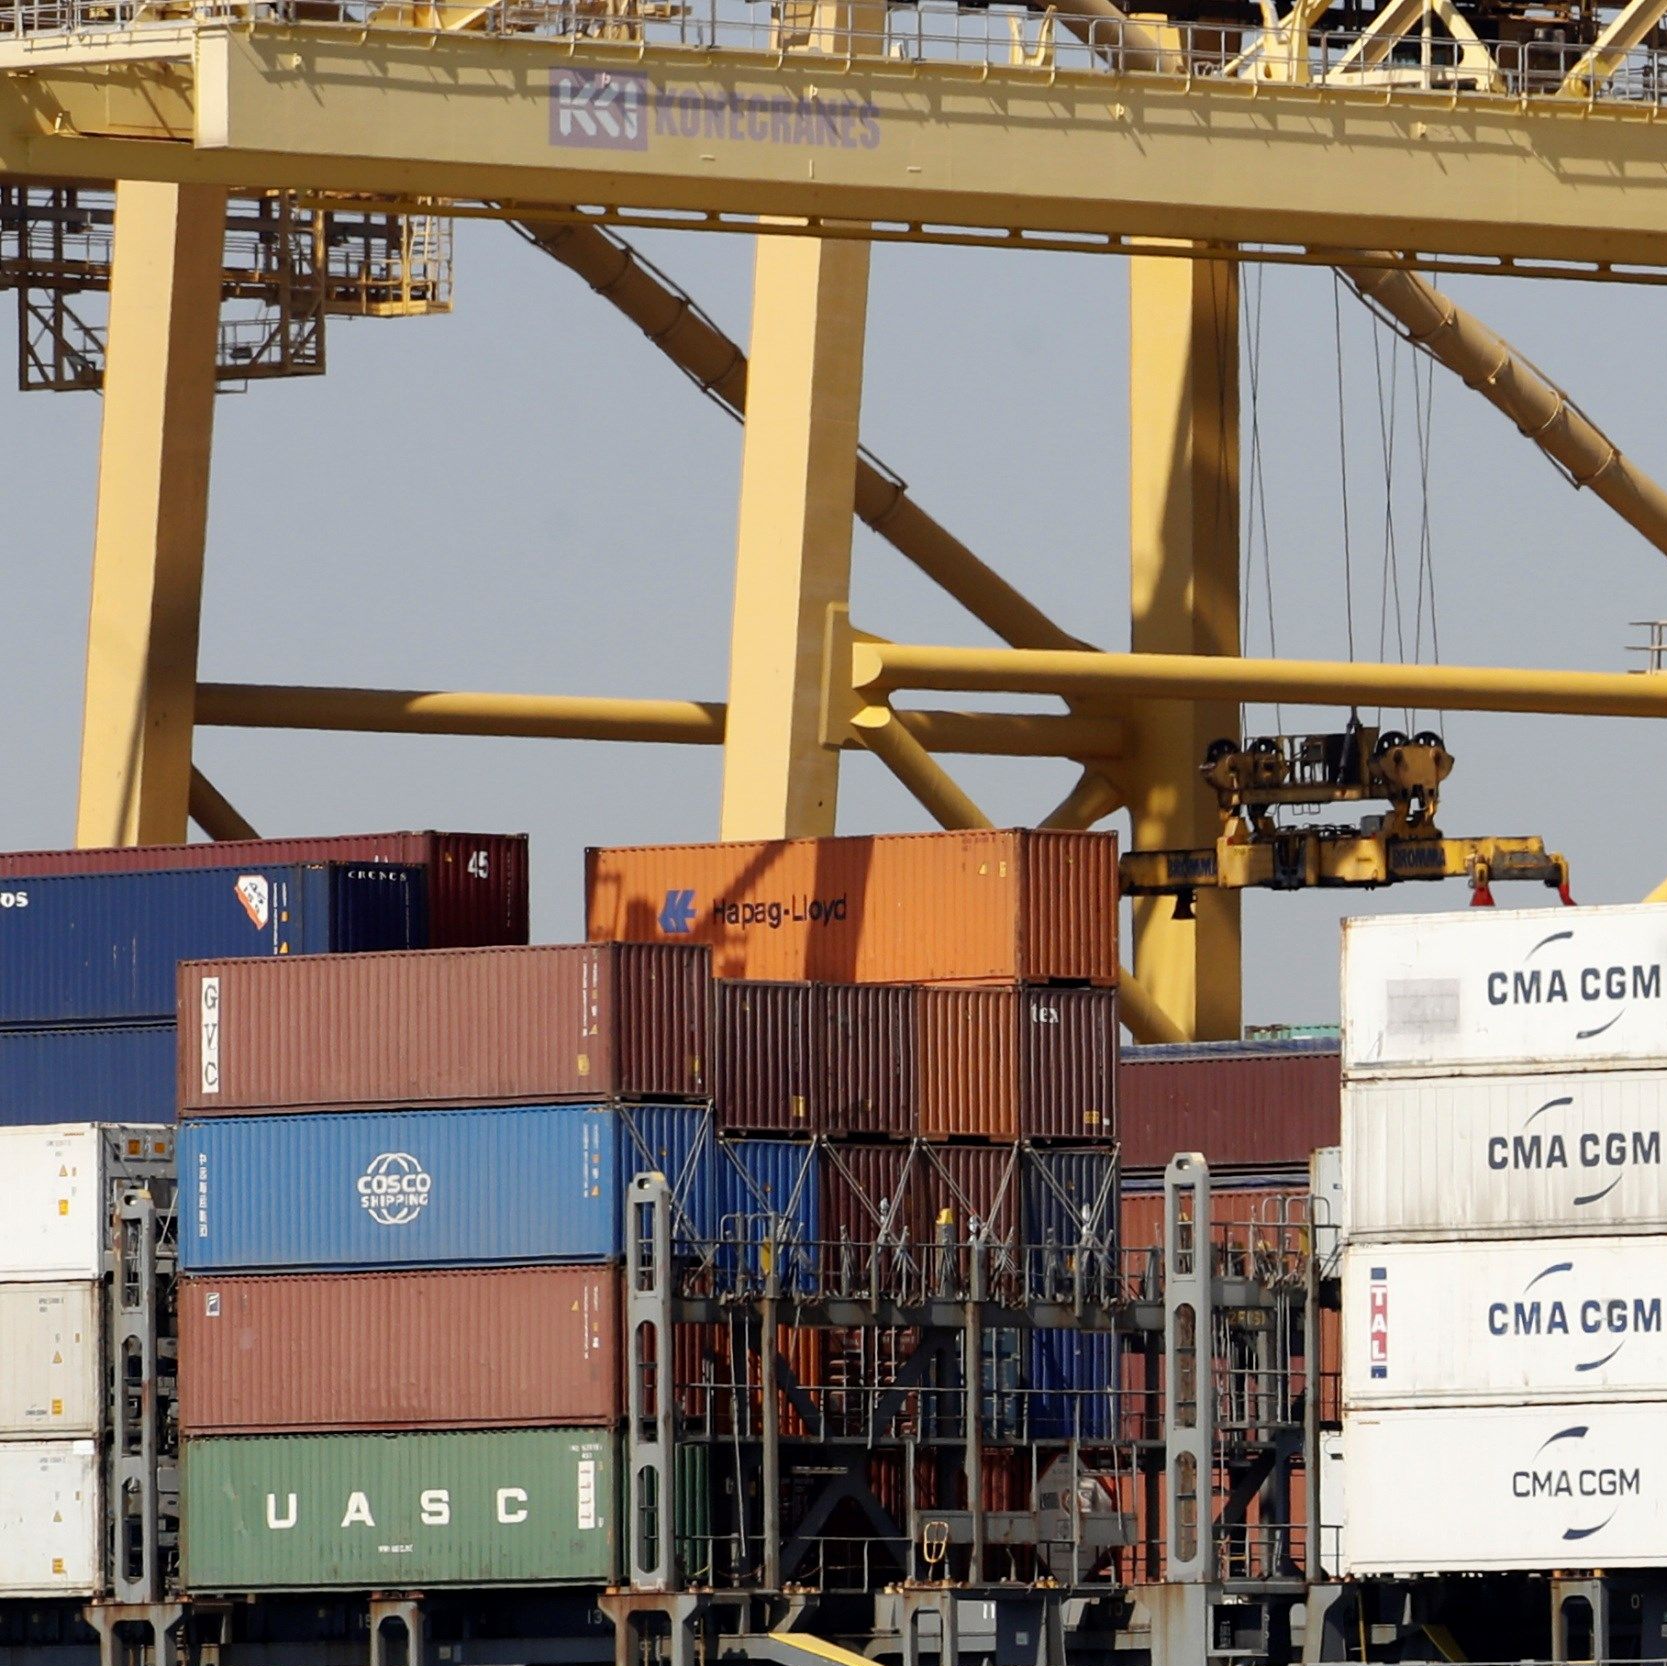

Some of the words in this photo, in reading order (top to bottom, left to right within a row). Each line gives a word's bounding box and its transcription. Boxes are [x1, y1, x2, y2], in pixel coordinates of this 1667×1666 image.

[655, 86, 881, 150] KONECRANES
[467, 851, 490, 879] 45
[711, 892, 848, 930] Hapag-Lloyd
[1487, 969, 1568, 1006] CMA
[1580, 964, 1662, 1000] CGM
[1030, 1004, 1060, 1024] tex
[1487, 1134, 1568, 1171] CMA
[1579, 1131, 1662, 1166] CGM
[356, 1173, 431, 1194] COSCO
[360, 1193, 429, 1209] SHIPPING
[1370, 1285, 1389, 1361] TAL
[1487, 1301, 1569, 1337] CMA
[1580, 1298, 1663, 1334] CGM
[1512, 1470, 1573, 1498] CMA
[1579, 1468, 1641, 1496] CGM
